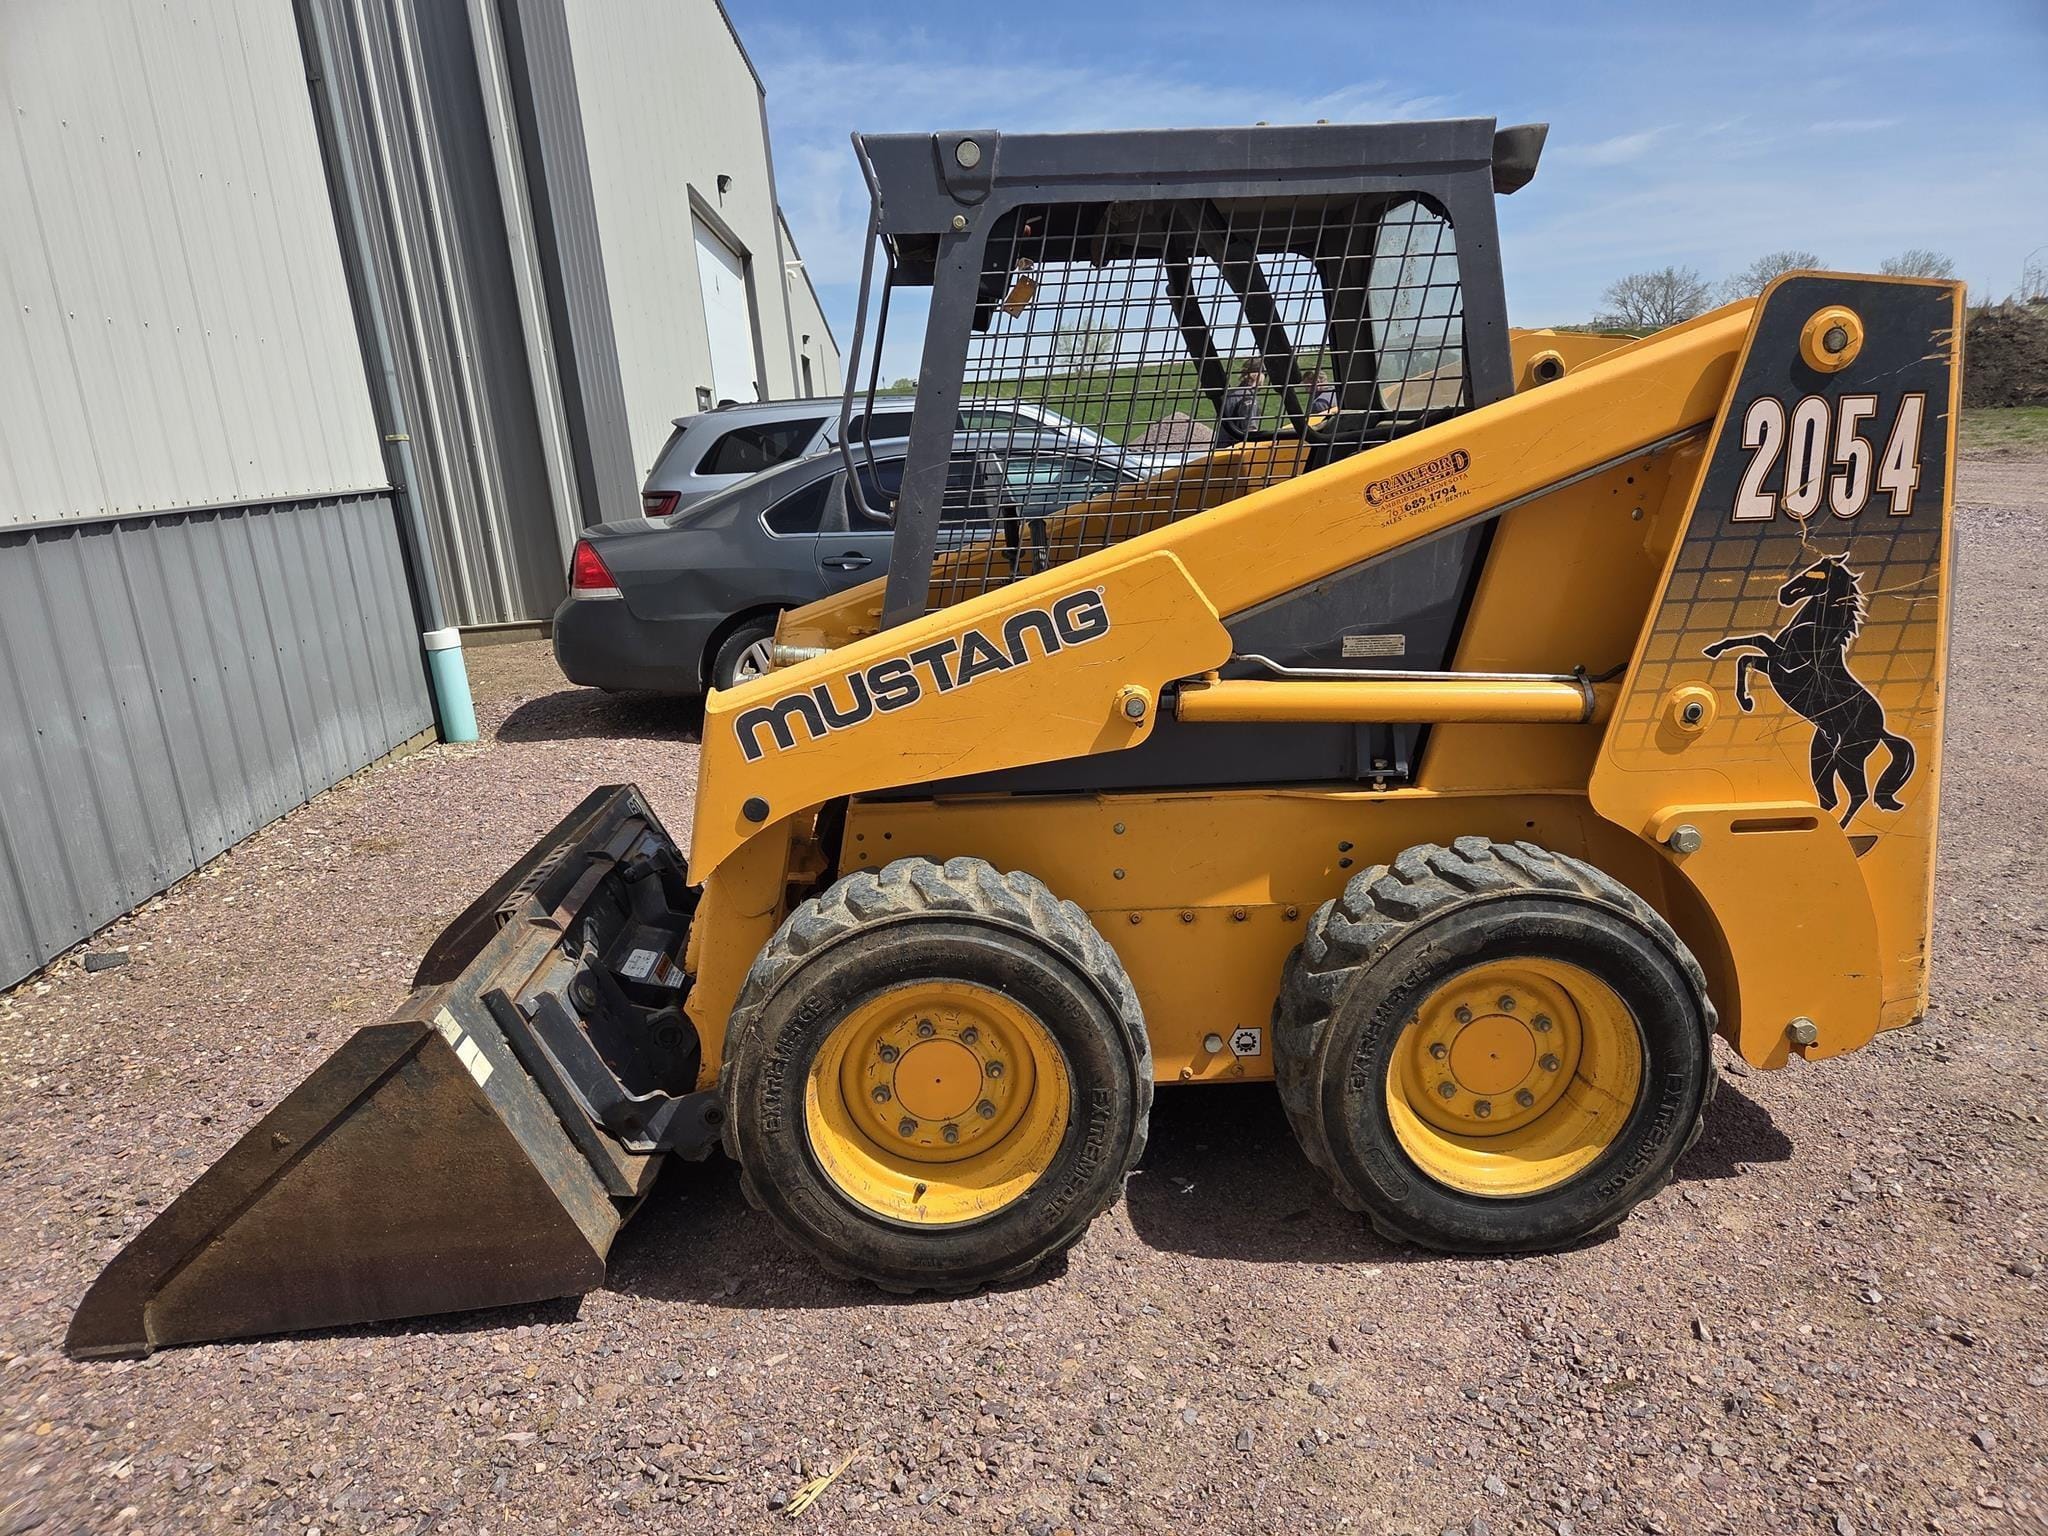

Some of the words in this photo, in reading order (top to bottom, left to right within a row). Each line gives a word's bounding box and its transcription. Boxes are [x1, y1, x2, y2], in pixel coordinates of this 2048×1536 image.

[1364, 447, 1471, 507] CRAWFORD
[1424, 473, 1469, 494] MINNESOTA
[1731, 391, 1928, 523] 2054
[1381, 514, 1402, 529] SALES
[1409, 502, 1437, 517] SERVICE
[1445, 489, 1471, 504] RENTAL
[734, 588, 1111, 763] MUSTANG
